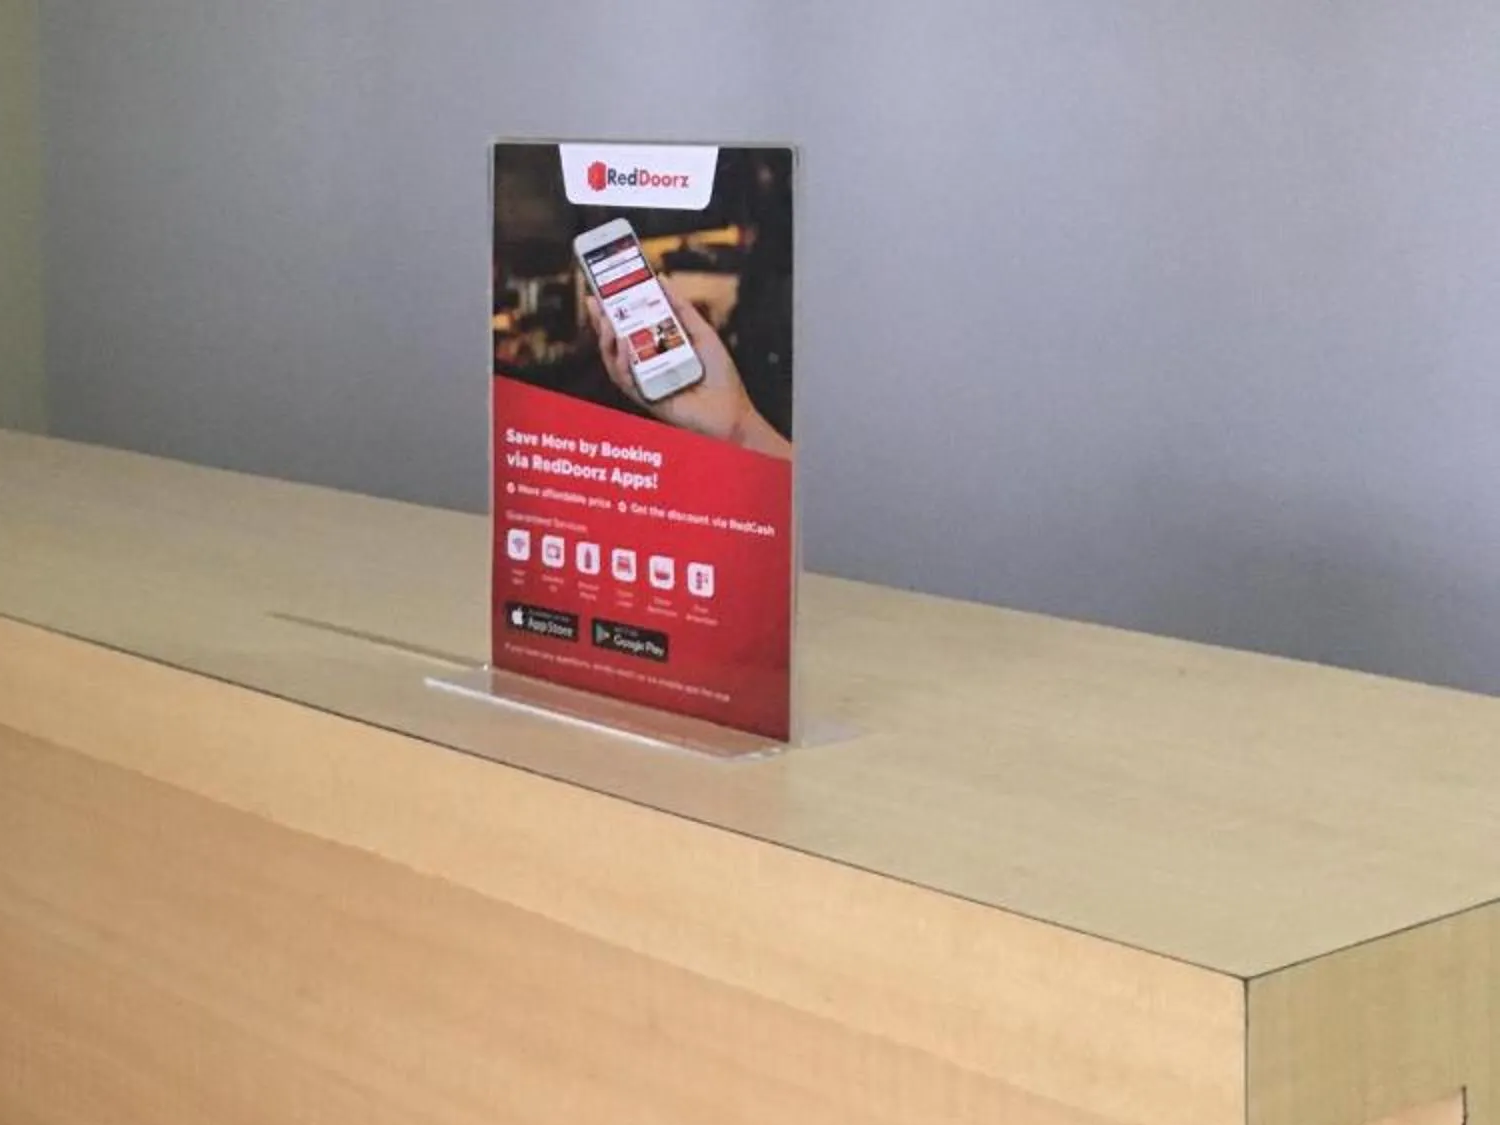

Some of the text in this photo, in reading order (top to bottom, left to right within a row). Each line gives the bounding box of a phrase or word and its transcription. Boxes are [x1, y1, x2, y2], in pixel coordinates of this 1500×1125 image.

[607, 168, 689, 188] RedDoorz
[506, 428, 662, 467] Save More by Booking
[506, 451, 658, 490] via RedDoorz Apps!
